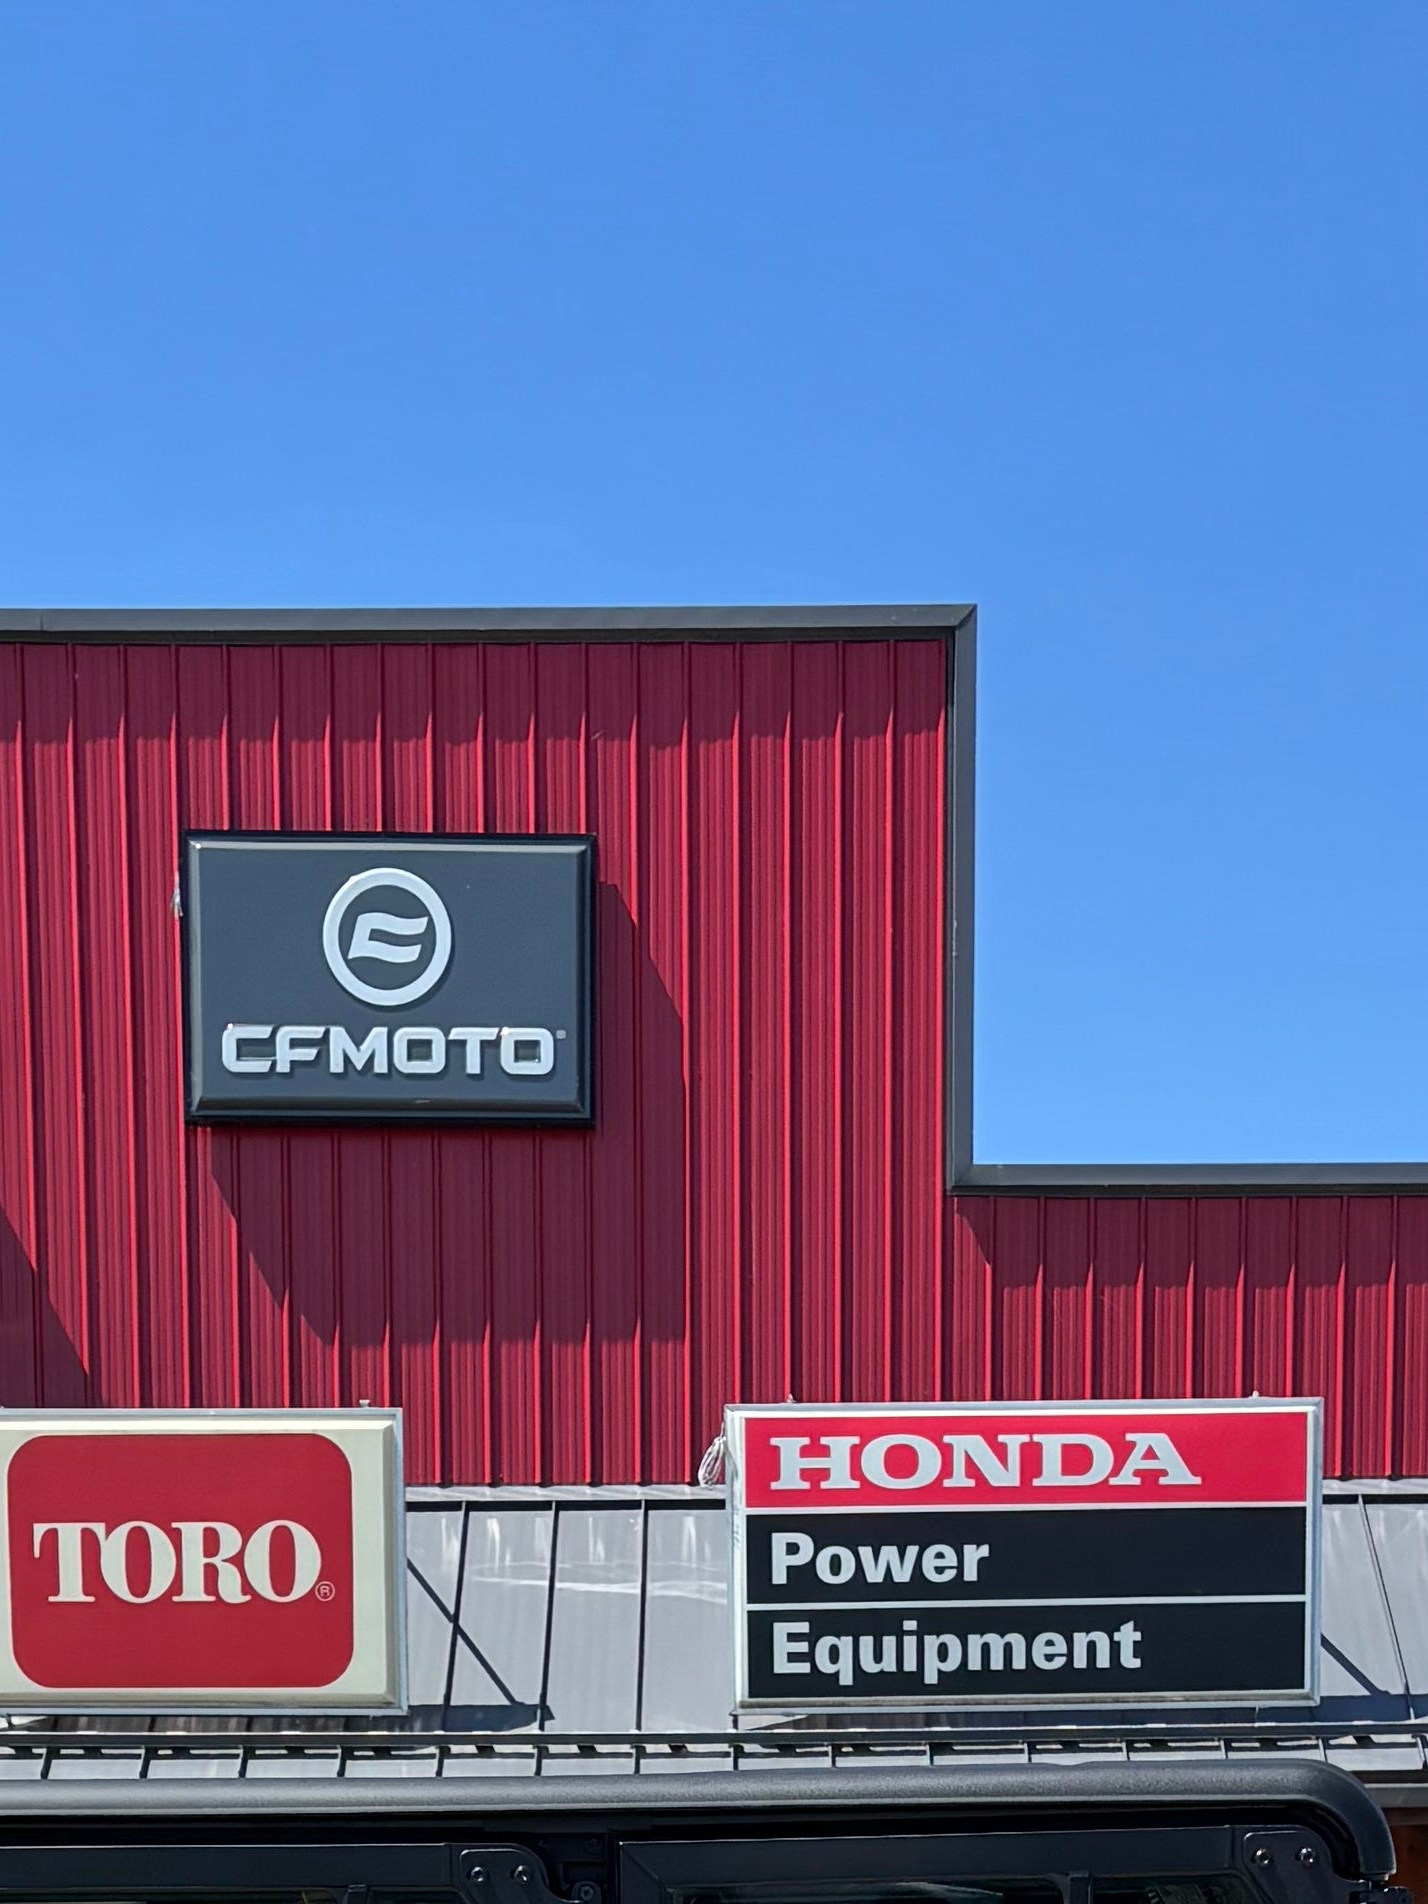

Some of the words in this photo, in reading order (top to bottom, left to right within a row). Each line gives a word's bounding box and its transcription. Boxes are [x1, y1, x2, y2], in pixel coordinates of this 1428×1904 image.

[222, 1023, 555, 1075] CFMOTO
[770, 1432, 1202, 1489] HONDA
[33, 1519, 322, 1603] TORO
[771, 1531, 990, 1585] Power
[773, 1620, 1142, 1685] Equipment
